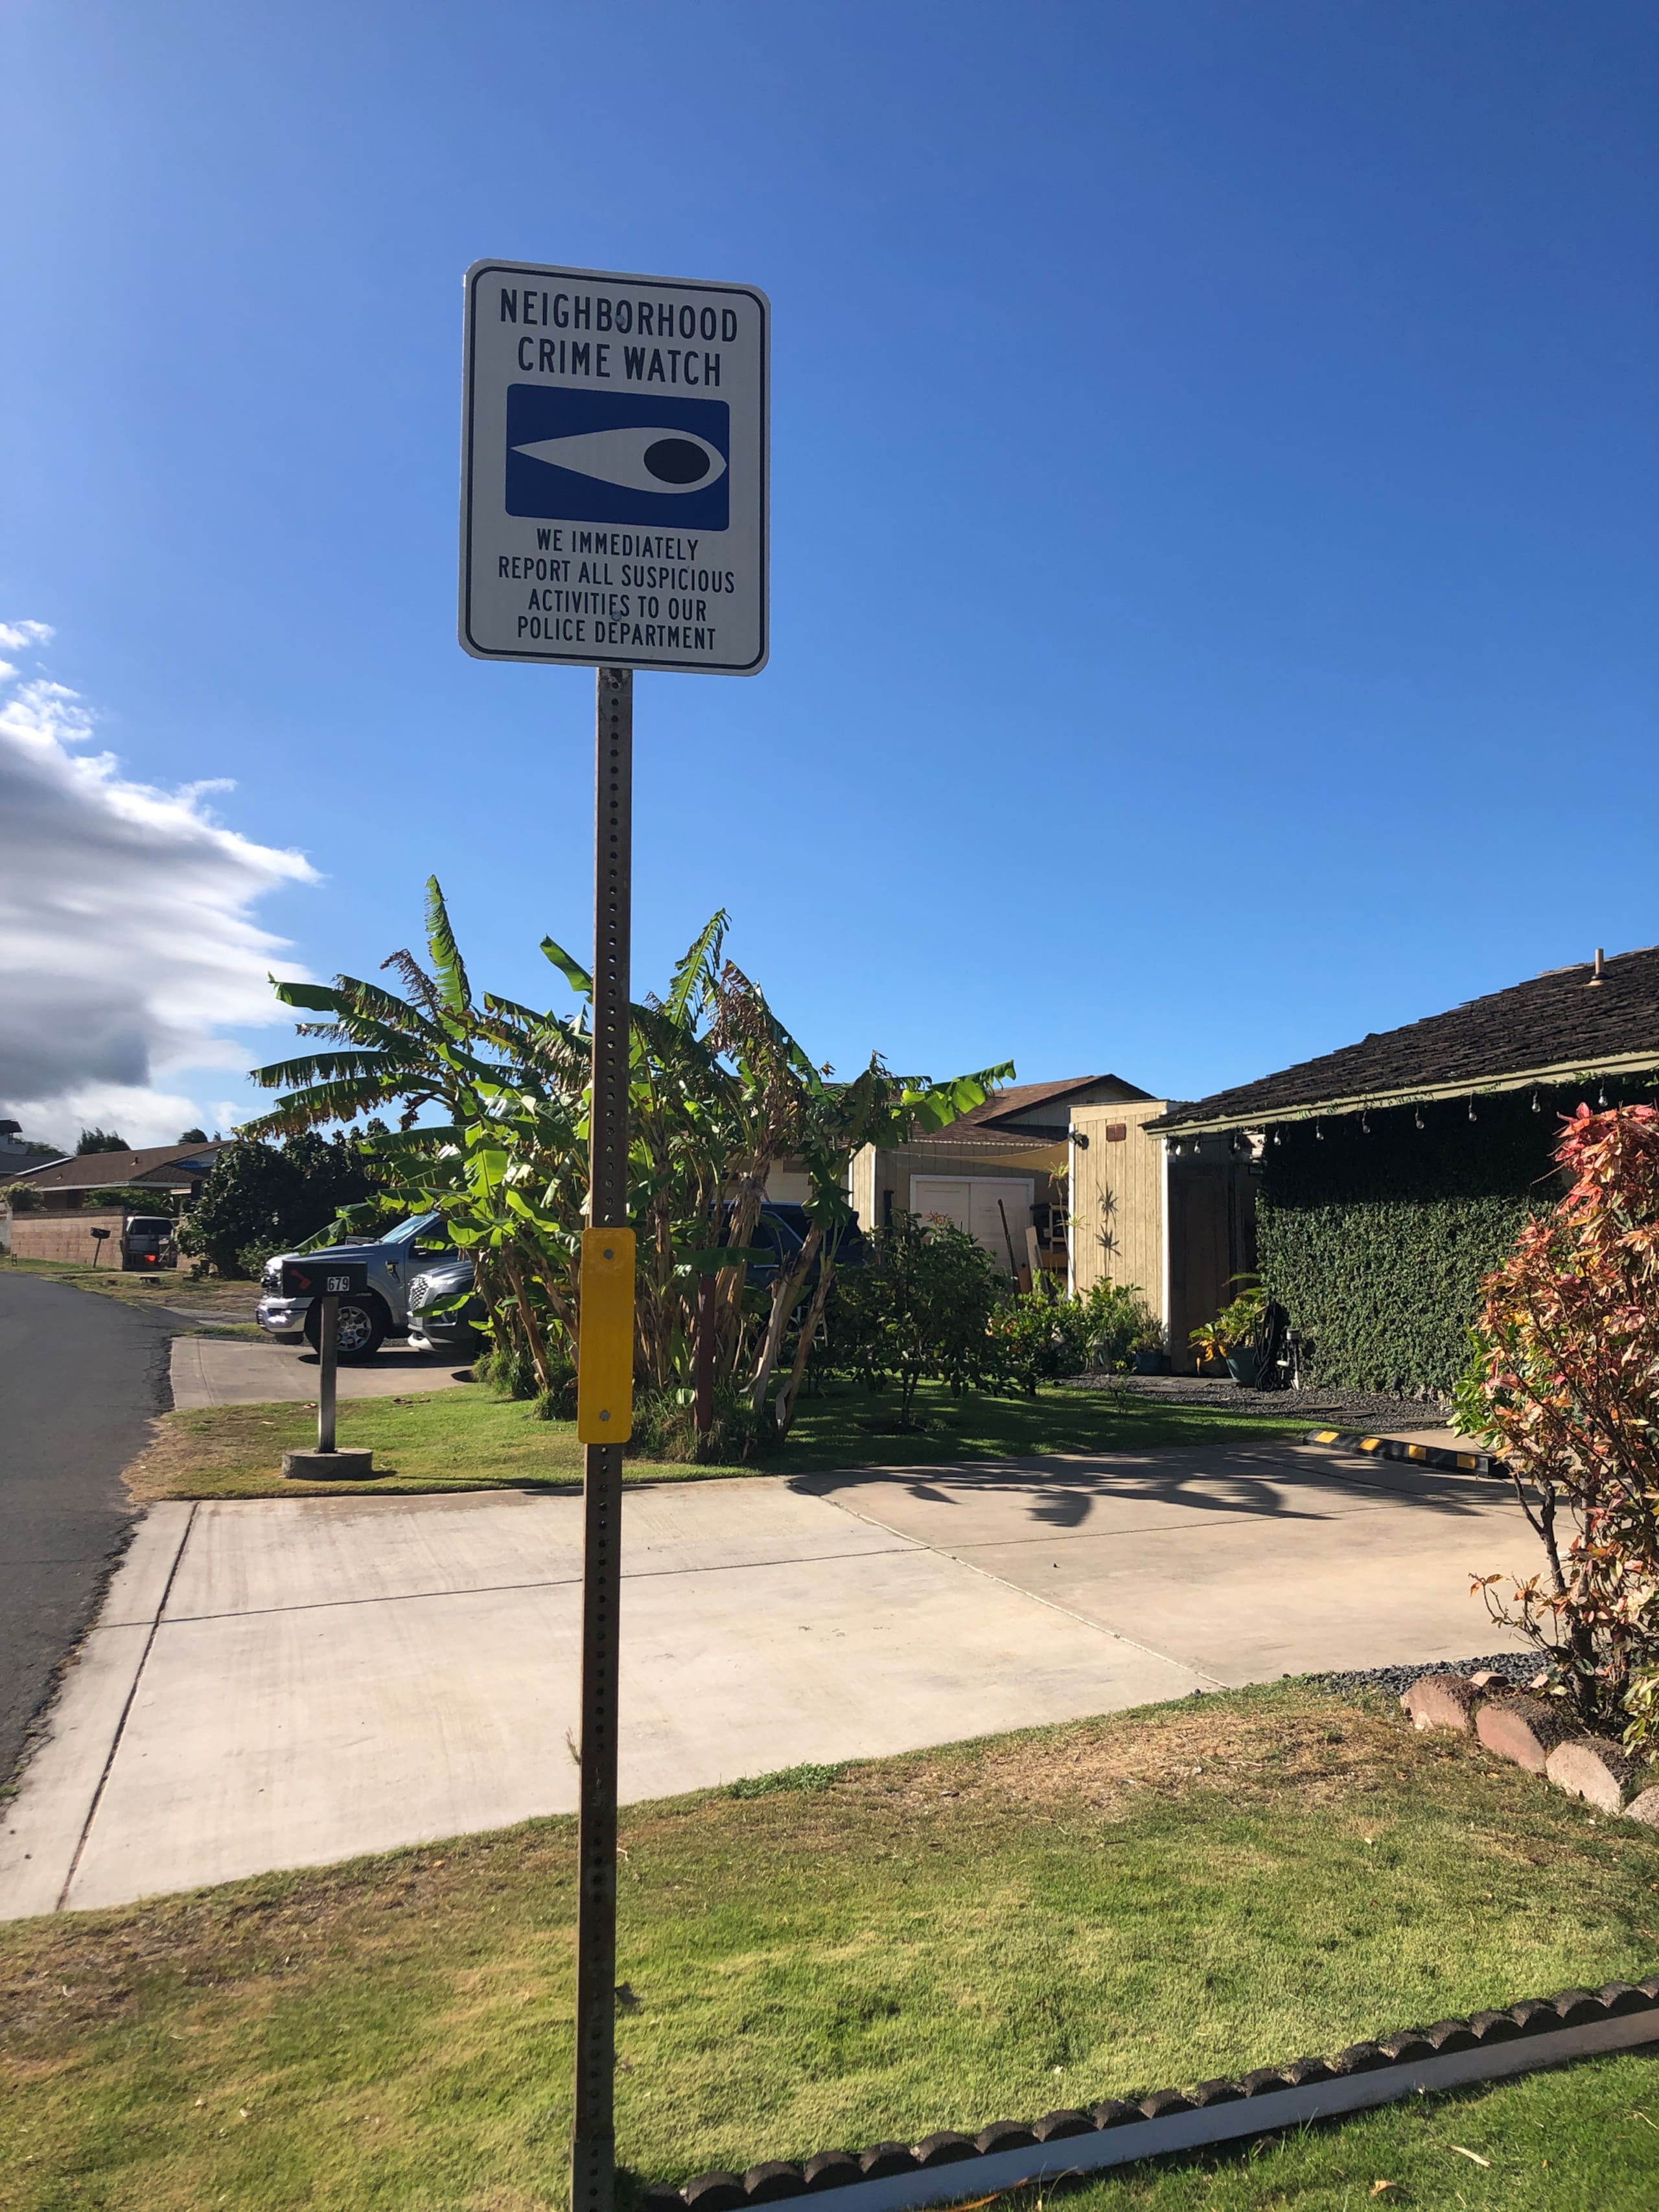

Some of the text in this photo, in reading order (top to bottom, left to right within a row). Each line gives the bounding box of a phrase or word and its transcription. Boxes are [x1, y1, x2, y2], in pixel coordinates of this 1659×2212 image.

[500, 288, 737, 343] NEIGHBORHOOD
[518, 336, 721, 387] CRIME WATCH
[537, 528, 699, 561] WE IMMEDIATELY
[498, 555, 735, 594] REPORT ALL SUSPICIOUS
[528, 588, 706, 622] ACTIVITIES TO OUR
[518, 616, 716, 650] POLICE DEPARTMENT
[329, 1277, 348, 1290] 679
